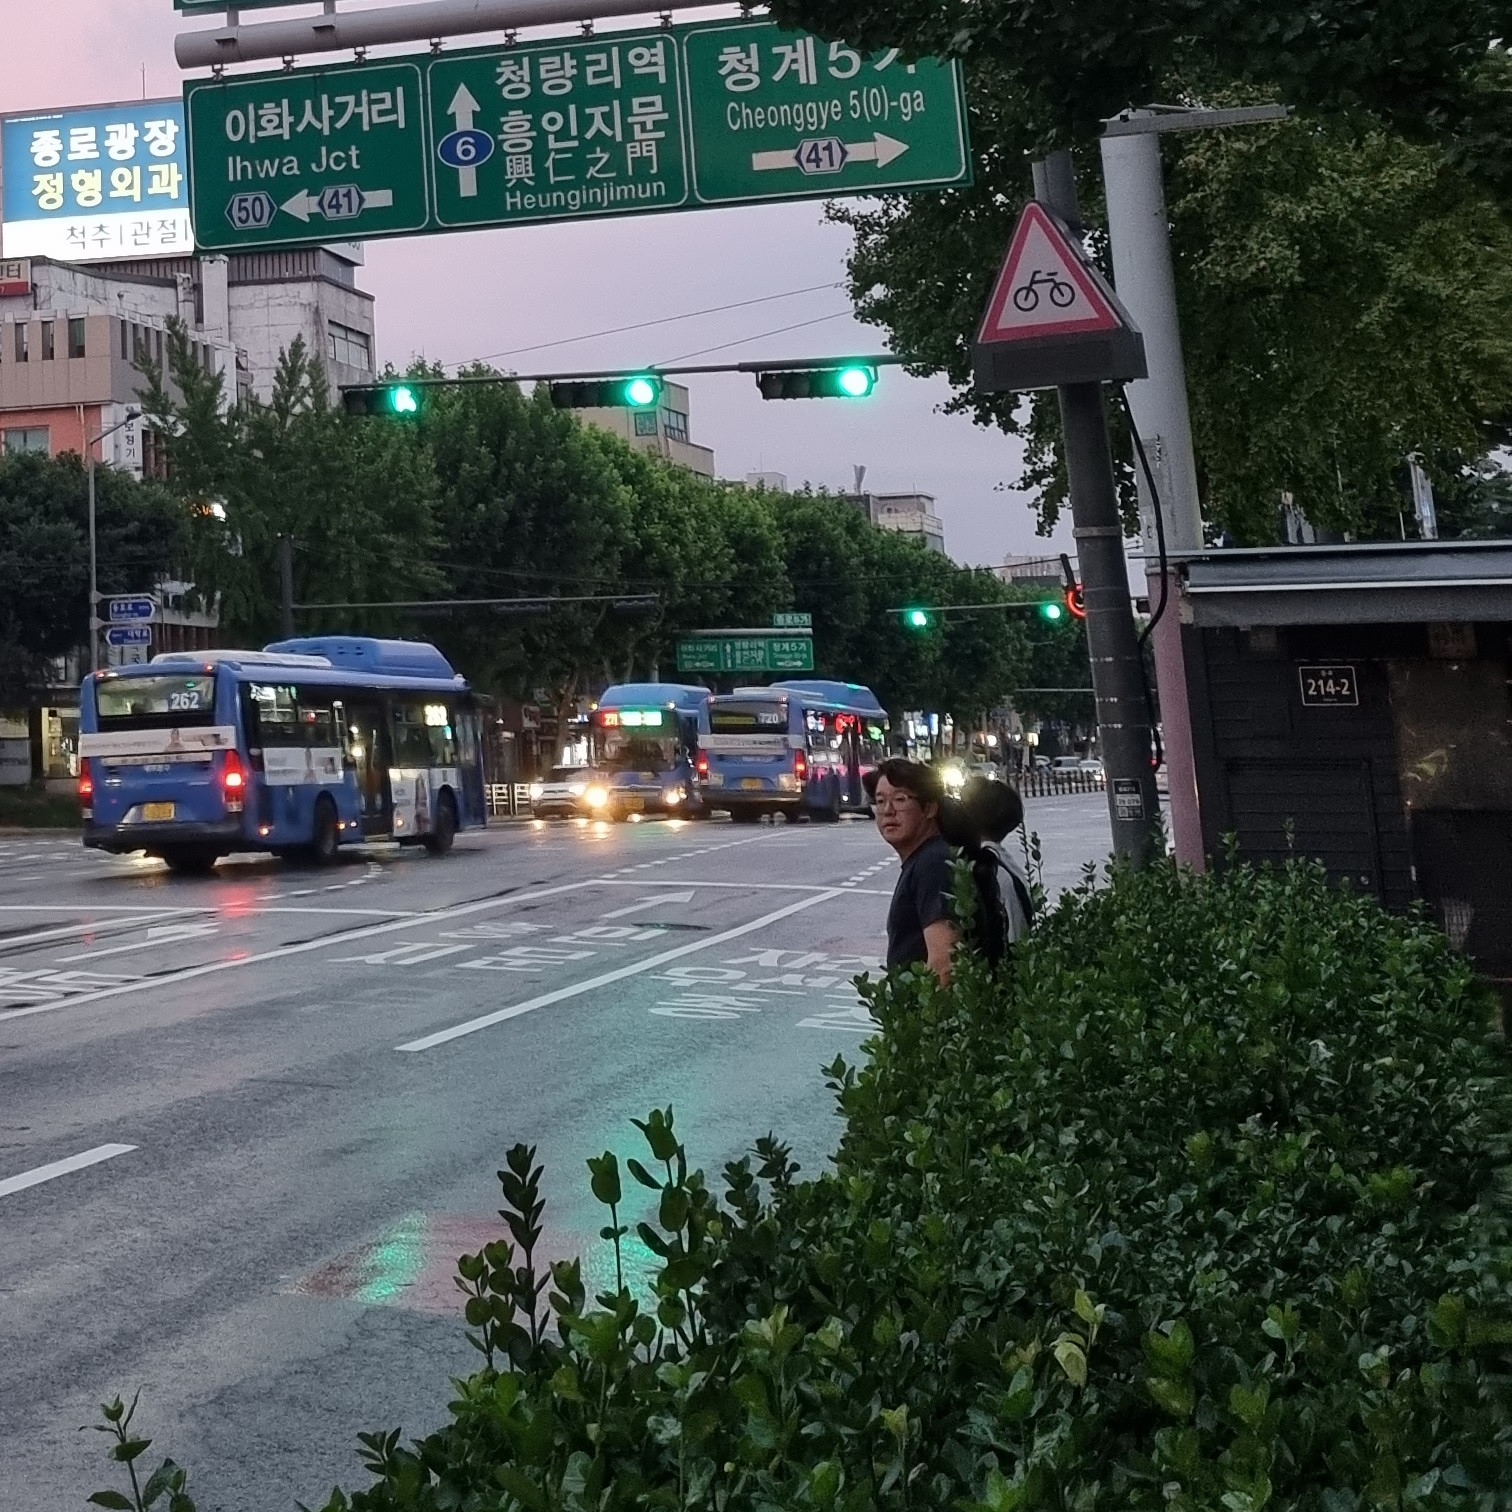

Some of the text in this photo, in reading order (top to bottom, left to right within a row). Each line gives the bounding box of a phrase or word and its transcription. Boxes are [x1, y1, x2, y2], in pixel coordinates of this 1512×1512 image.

[495, 40, 667, 100] 청량리역
[224, 86, 406, 144] 이화사거리
[497, 94, 670, 154] 흥인지문
[726, 85, 926, 132] Cheonggye 5(0)-ga
[29, 119, 180, 167] 종로광장
[455, 136, 477, 161] 6
[805, 140, 835, 169] 41
[227, 145, 361, 182] Ihwa Jct
[504, 140, 659, 188] 興仁之門
[31, 163, 183, 211] 정형외과
[236, 187, 355, 225] 50 41
[505, 180, 666, 211] Heunginjimun
[66, 219, 178, 250] 척추 관절
[171, 692, 199, 710] 262
[1307, 678, 1351, 696] 214-2
